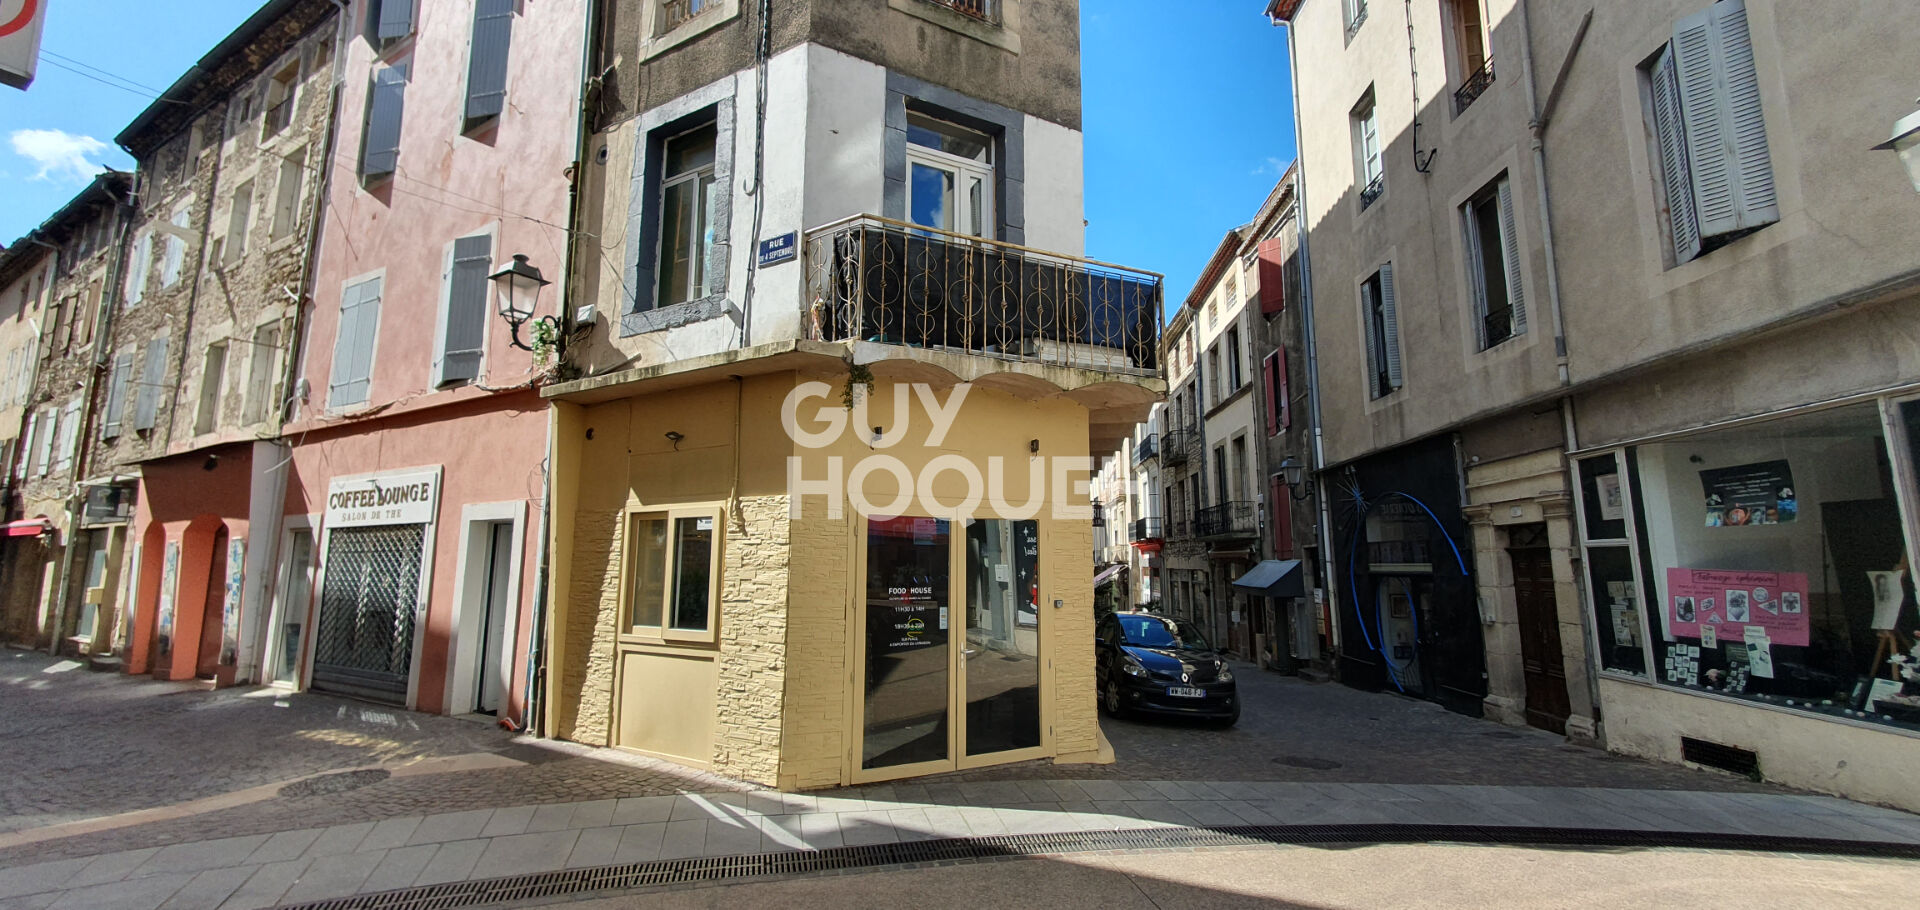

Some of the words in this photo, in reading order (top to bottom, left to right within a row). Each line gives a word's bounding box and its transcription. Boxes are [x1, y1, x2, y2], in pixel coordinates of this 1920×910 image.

[769, 237, 784, 249] RUE
[329, 489, 376, 510] COFFEE
[376, 482, 430, 507] LOUNGE
[342, 511, 367, 522] SALON
[371, 510, 380, 519] DE
[386, 509, 402, 519] THE
[888, 587, 907, 595] FOOD
